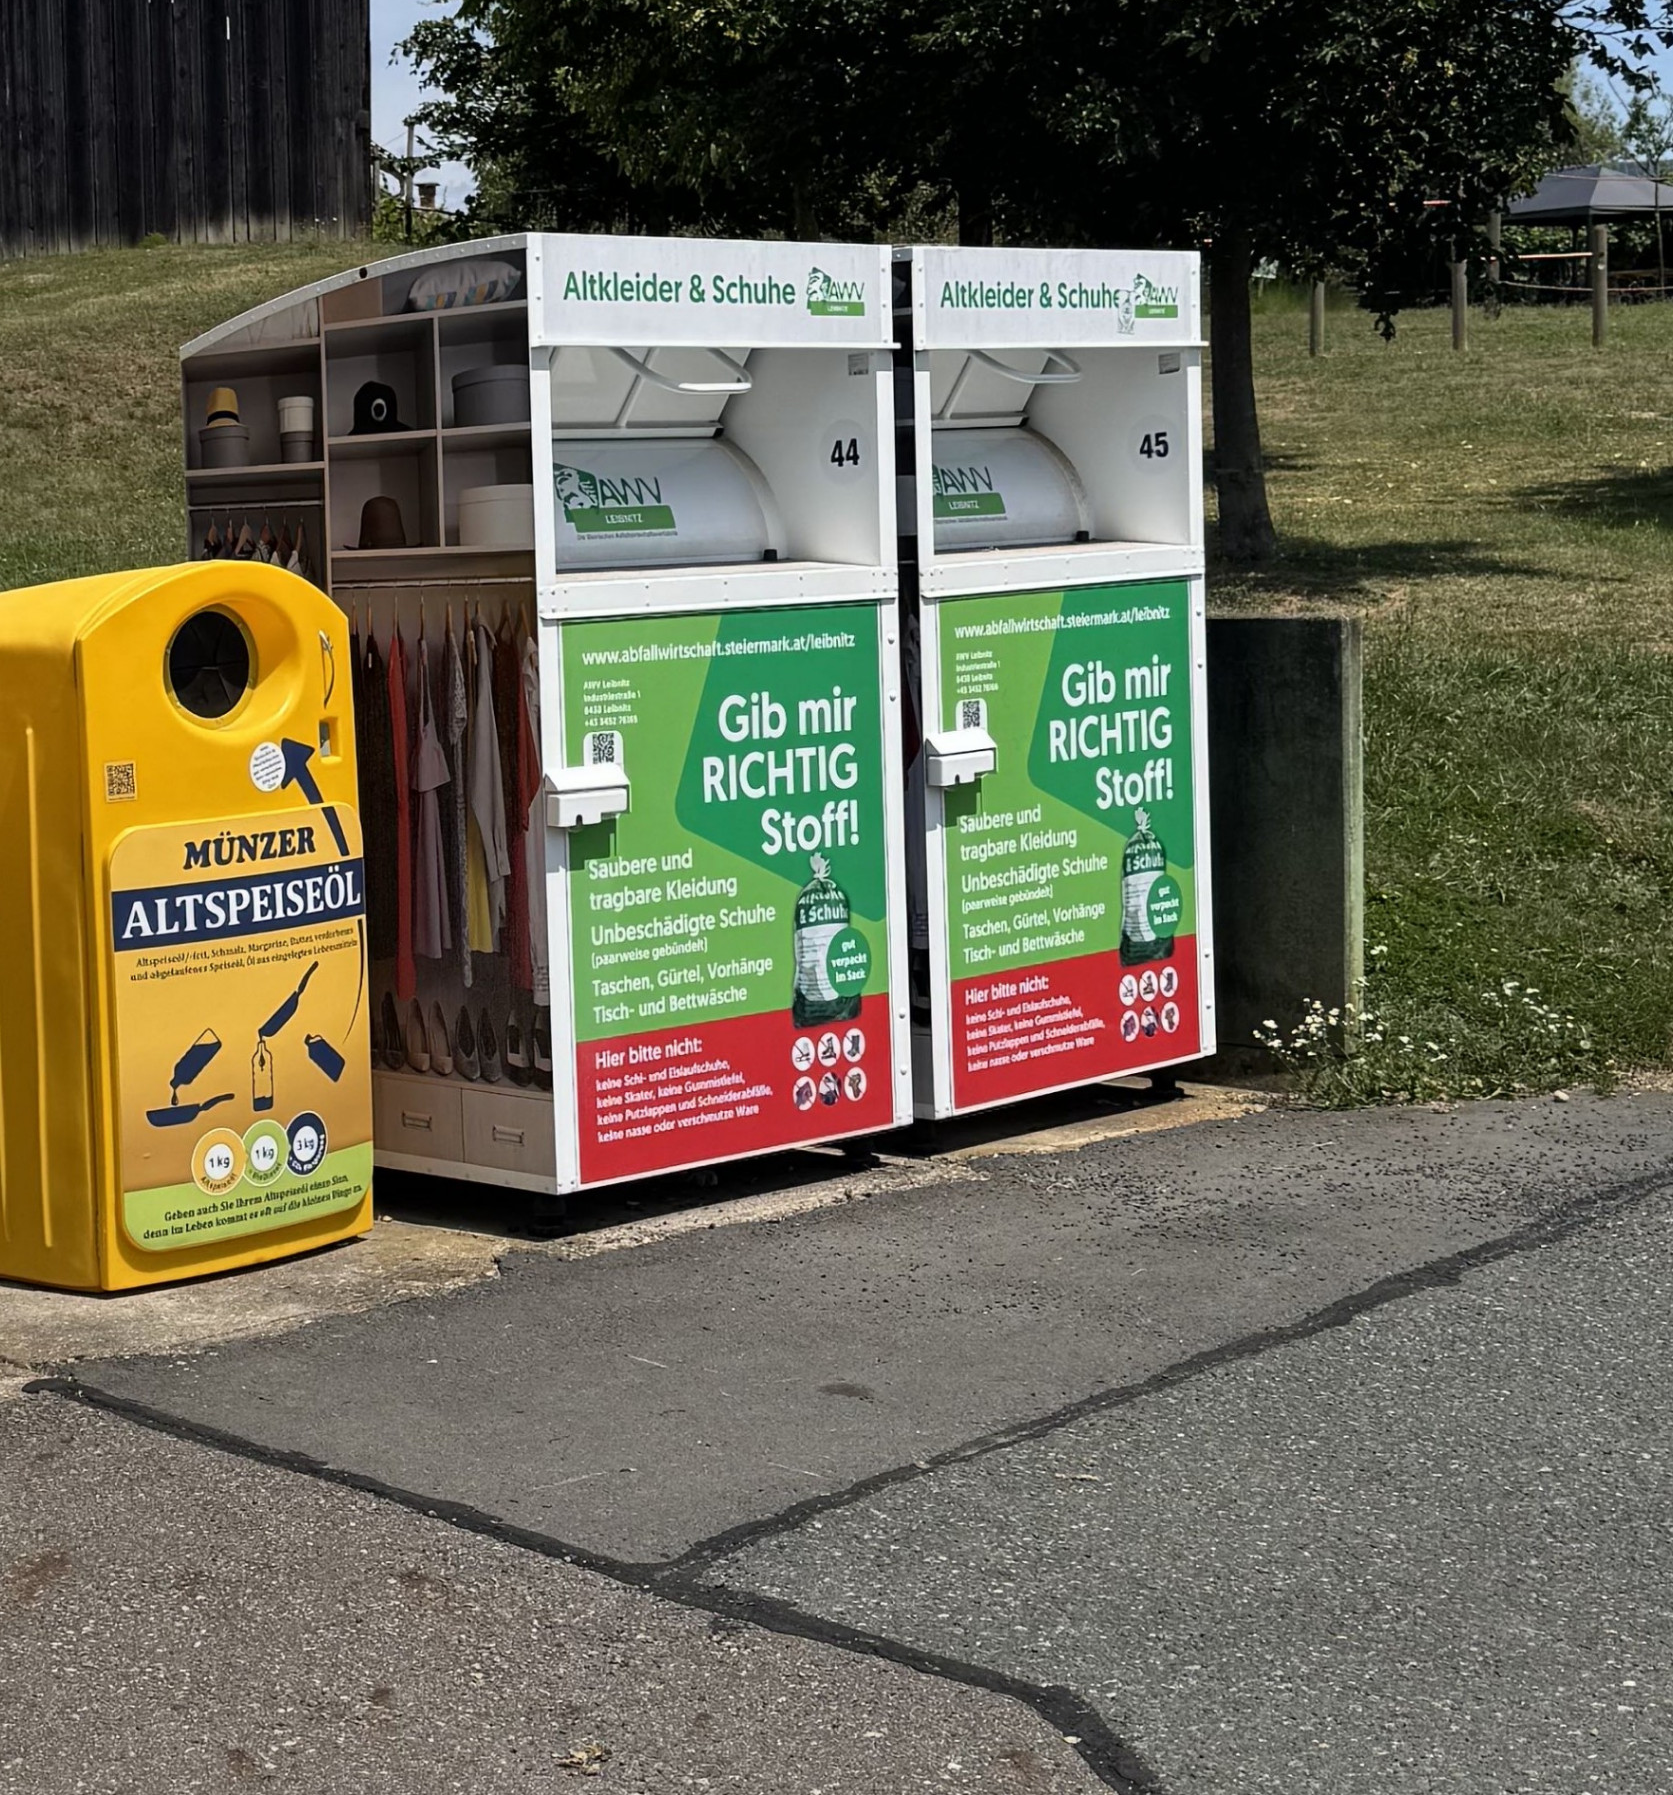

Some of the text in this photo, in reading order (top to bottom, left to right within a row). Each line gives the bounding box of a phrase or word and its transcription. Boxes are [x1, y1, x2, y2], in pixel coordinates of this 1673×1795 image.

[563, 271, 796, 305] Altkleider & Schuhe
[941, 281, 1034, 309] Altkleider
[1039, 282, 1052, 308] &
[831, 438, 860, 467] 44
[1139, 432, 1169, 458] 45
[599, 476, 661, 506] AWV
[940, 466, 993, 493] AWV
[955, 606, 1170, 639] www.abfallwirtschaft.steiermark.at/leibnitz
[582, 632, 856, 666] www.abfallwirtschaft.steiermark.at/leibnitz
[602, 679, 630, 689] Leibnitz
[1062, 654, 1172, 707] Gib mir
[717, 686, 858, 743] Gib mir
[1049, 706, 1173, 764] RICHTIG
[702, 742, 858, 804] RICHTIG
[1095, 756, 1174, 811] Stoff!
[761, 802, 860, 857] Stoff!
[960, 805, 1041, 834] Saubere und
[182, 826, 315, 871] MÜNZER
[961, 829, 1077, 862] tragbare Kleidung
[588, 850, 692, 880] Saubere und
[962, 854, 1107, 894] Unbeschädigte Schuhe
[122, 869, 361, 941] ALTSPEISEÖL
[590, 876, 738, 912] tragbare Kleidung
[962, 894, 1007, 914] (paarweise
[591, 904, 776, 946] Unbeschädigte Schuhe
[963, 903, 1105, 940] Taschen, Gürtel, Vorhänge
[592, 937, 708, 969] (paarweise gebündelt)
[832, 952, 867, 968] verpackt
[842, 940, 856, 952] gut
[964, 930, 1084, 964] Tisch- und Bettwäsche
[130, 972, 147, 981] und
[247, 956, 255, 966] Öl
[272, 948, 312, 962] eingelegten
[592, 956, 773, 997] Taschen, Gürtel, Vorhänge
[836, 968, 866, 983] im Sack
[594, 986, 747, 1024] Tisch- und Bettwäsche
[965, 976, 1049, 1006] Hier bitte nicht:
[966, 1013, 986, 1025] keine
[1007, 1004, 1021, 1016] und
[967, 1029, 987, 1040] keine
[1014, 1019, 1033, 1030] keine
[596, 1038, 703, 1069] Hier bitte nicht:
[967, 1045, 988, 1057] keine
[1030, 1031, 1044, 1043] und
[968, 1037, 1094, 1072] keine oder Ware
[596, 1059, 730, 1092] keine Schi- und Eislaufschuhe,
[597, 1072, 745, 1108] keine Skater, keine Gummistiefel,
[597, 1084, 773, 1126] keine Putzlappen und Schneiderabfälle,
[598, 1104, 759, 1142] keine nasse oder Ware
[256, 1146, 274, 1159] 1 kg
[297, 1138, 314, 1150] 3 kg
[209, 1156, 230, 1168] 1 kg
[144, 1230, 168, 1239] denn
[172, 1226, 183, 1234] im
[186, 1221, 213, 1232] Leben
[216, 1213, 247, 1226] kommt
[260, 1206, 271, 1216] oft
[274, 1203, 287, 1214] auf
[288, 1200, 300, 1211] die
[165, 1210, 194, 1221] Geben
[197, 1203, 218, 1215] auch
[220, 1201, 233, 1211] Sie
[236, 1196, 262, 1209] Ihrem
